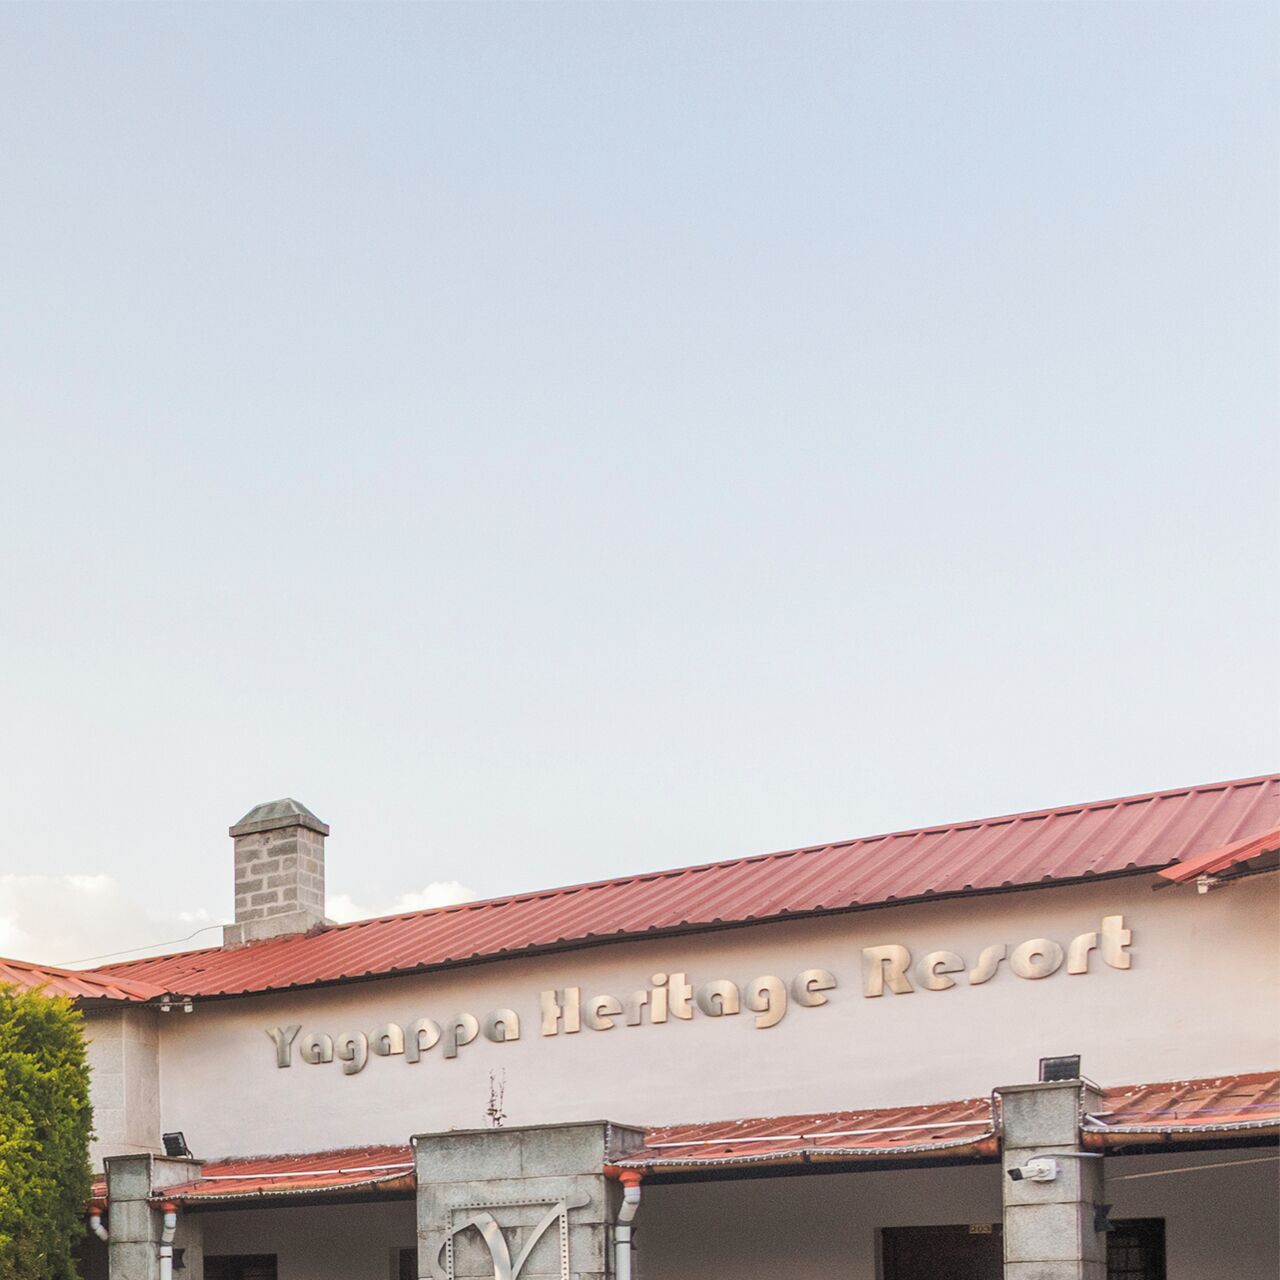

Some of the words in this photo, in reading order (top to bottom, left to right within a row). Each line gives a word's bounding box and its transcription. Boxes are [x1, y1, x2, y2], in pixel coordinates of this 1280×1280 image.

[266, 1008, 520, 1075] Yagappa
[540, 972, 837, 1036] Heritage
[862, 915, 1131, 998] Resort
